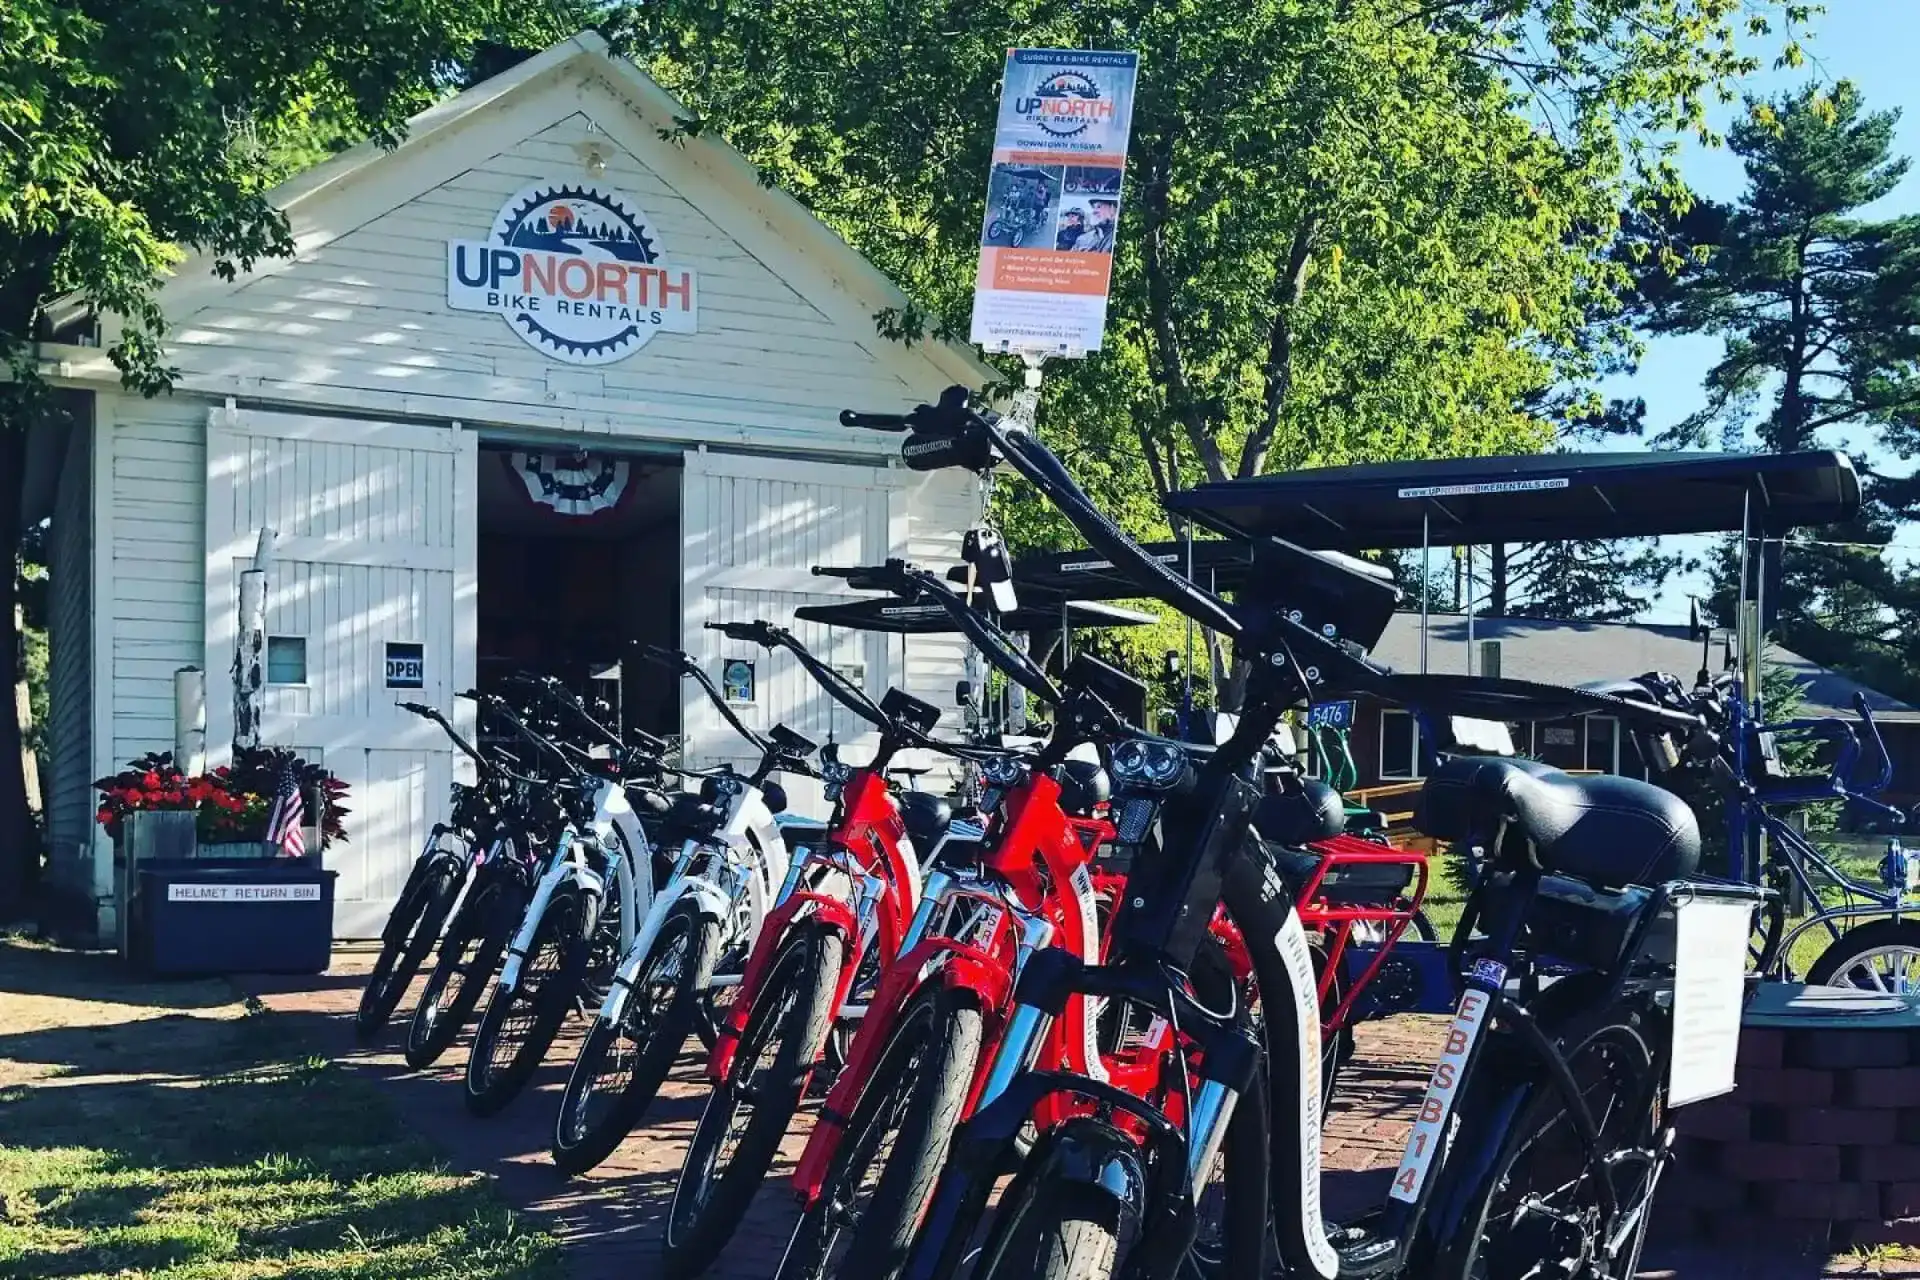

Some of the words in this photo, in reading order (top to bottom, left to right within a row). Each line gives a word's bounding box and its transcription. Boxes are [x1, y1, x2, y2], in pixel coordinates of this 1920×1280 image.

[1022, 54, 1054, 62] SURREY
[1063, 55, 1092, 63] E-BIKE
[1092, 56, 1129, 65] RENTALS
[1016, 97, 1114, 117] UPNORTH
[1054, 115, 1099, 124] RENTALS
[1017, 140, 1068, 149] DOWNTOWN
[456, 245, 691, 312] UPNORTH
[487, 292, 541, 311] BIKE
[557, 302, 663, 325] RENTALS
[386, 661, 423, 677] OPEN
[1313, 705, 1343, 723] 5476
[175, 888, 228, 899] HELMET
[235, 888, 288, 899] RETURN
[294, 888, 315, 898] BIN
[1397, 995, 1482, 1194] EBSB14
